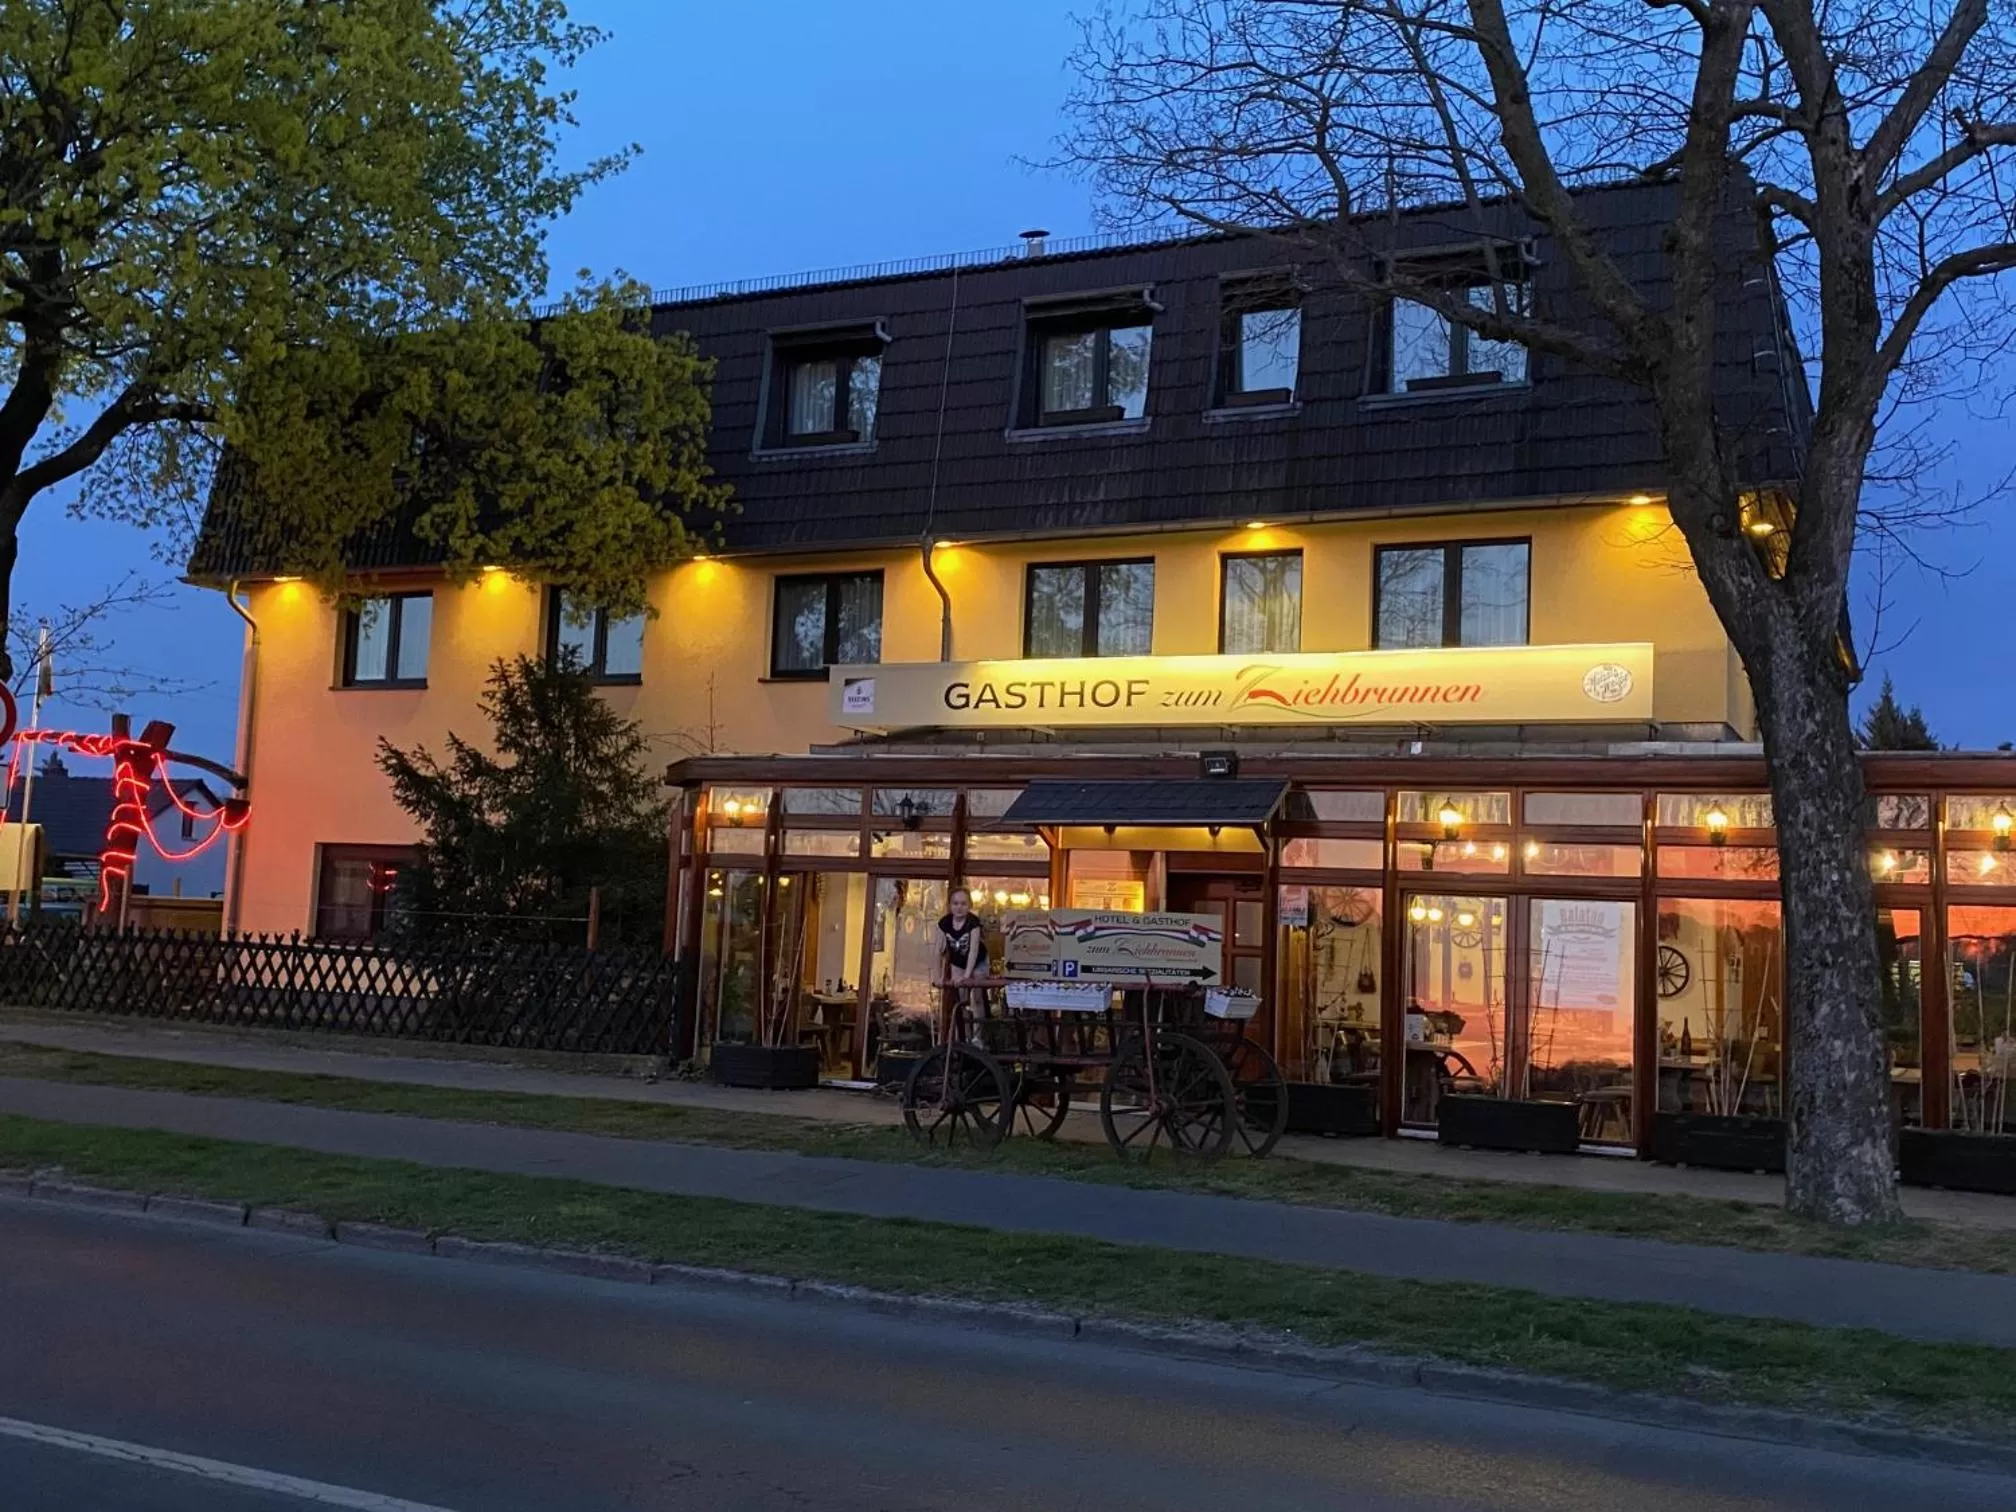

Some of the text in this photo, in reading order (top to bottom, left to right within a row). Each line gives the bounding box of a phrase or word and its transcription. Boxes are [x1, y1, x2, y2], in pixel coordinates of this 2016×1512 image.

[944, 664, 1483, 712] GASTHOF zum Ziehbrunnen
[1094, 914, 1191, 927] HOTEL & GASTHOF
[1086, 944, 1111, 954] zum
[1065, 962, 1075, 977] P
